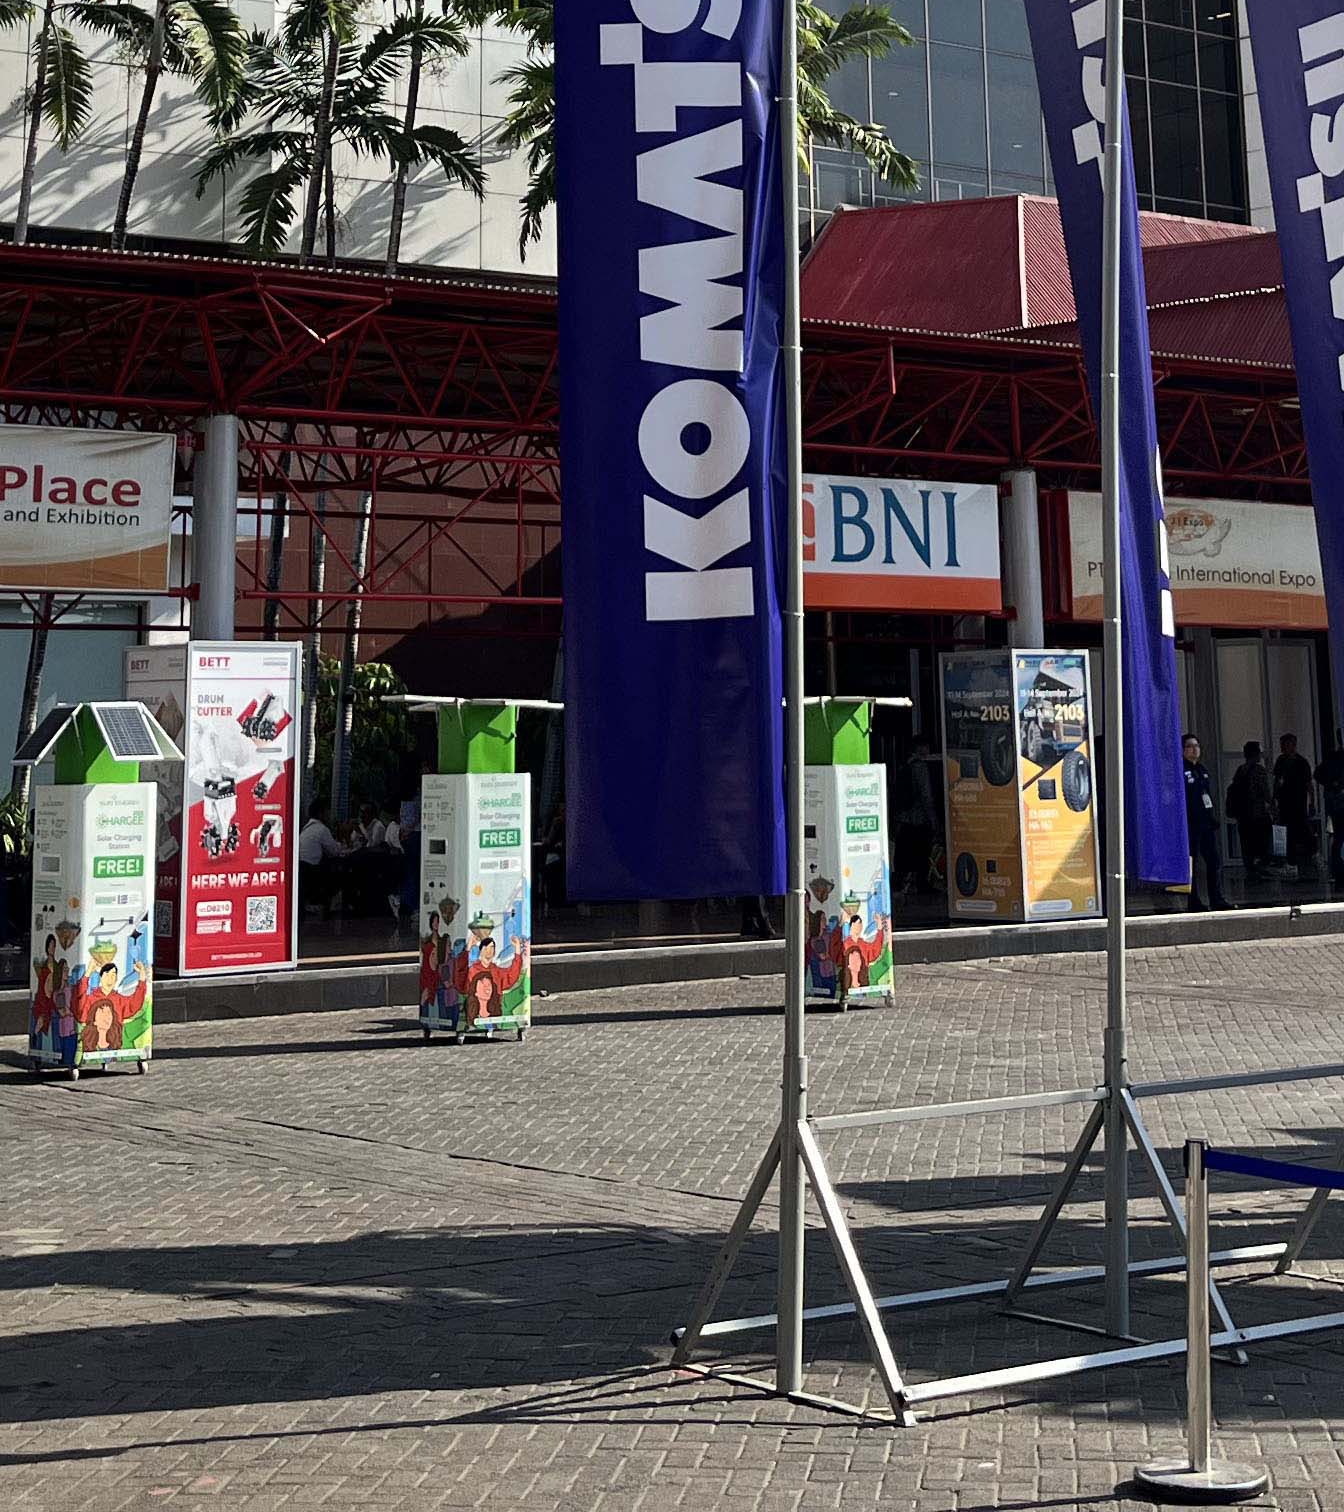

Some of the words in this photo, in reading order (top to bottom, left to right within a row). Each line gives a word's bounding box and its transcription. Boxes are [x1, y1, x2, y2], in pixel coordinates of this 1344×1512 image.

[3, 506, 40, 524] and
[47, 508, 140, 527] Exhibition
[830, 485, 961, 569] BNI
[1176, 565, 1275, 586] International
[1280, 571, 1317, 589] Expo
[130, 660, 149, 671] BETT
[199, 656, 231, 667] BETT
[197, 706, 233, 716] CUTTER
[980, 705, 1010, 721] 2103
[1054, 704, 1084, 720] 2103
[482, 830, 518, 846] FREE!
[97, 858, 140, 875] FREE!
[191, 874, 227, 889] HERE
[227, 873, 249, 888] WE
[250, 871, 277, 887] ARE
